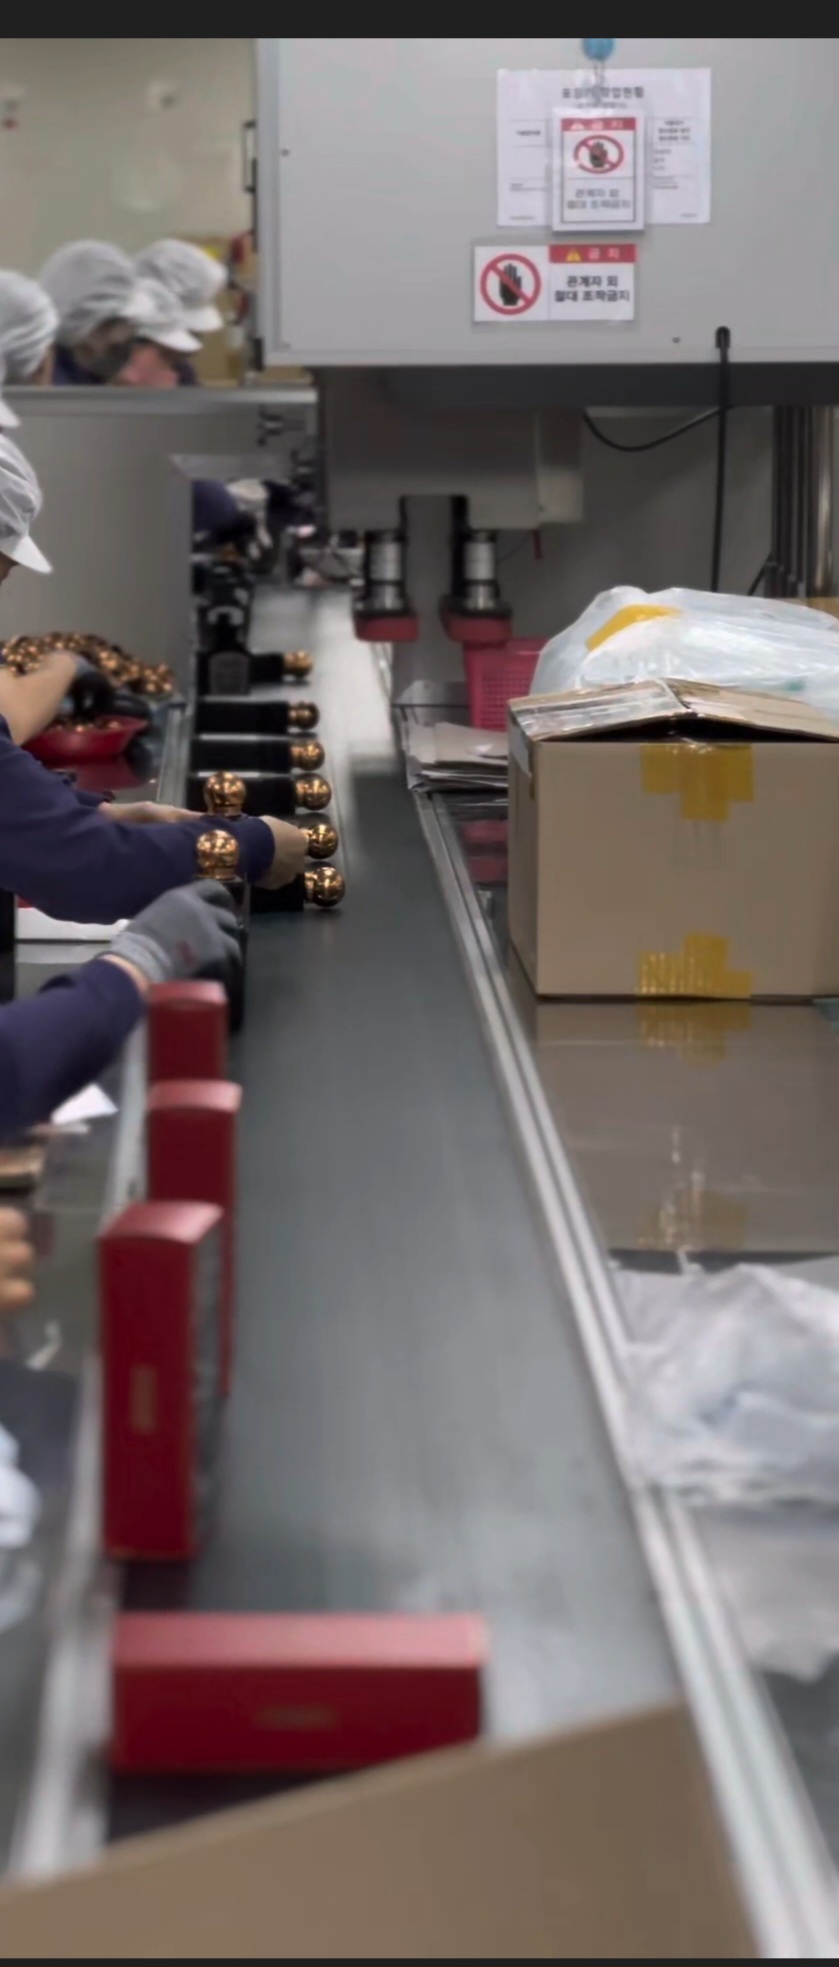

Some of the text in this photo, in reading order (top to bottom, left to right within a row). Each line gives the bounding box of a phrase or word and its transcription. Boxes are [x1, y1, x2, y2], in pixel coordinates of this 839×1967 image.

[566, 275, 619, 287] 관계자 외
[554, 290, 631, 302] 절대 조작금지
